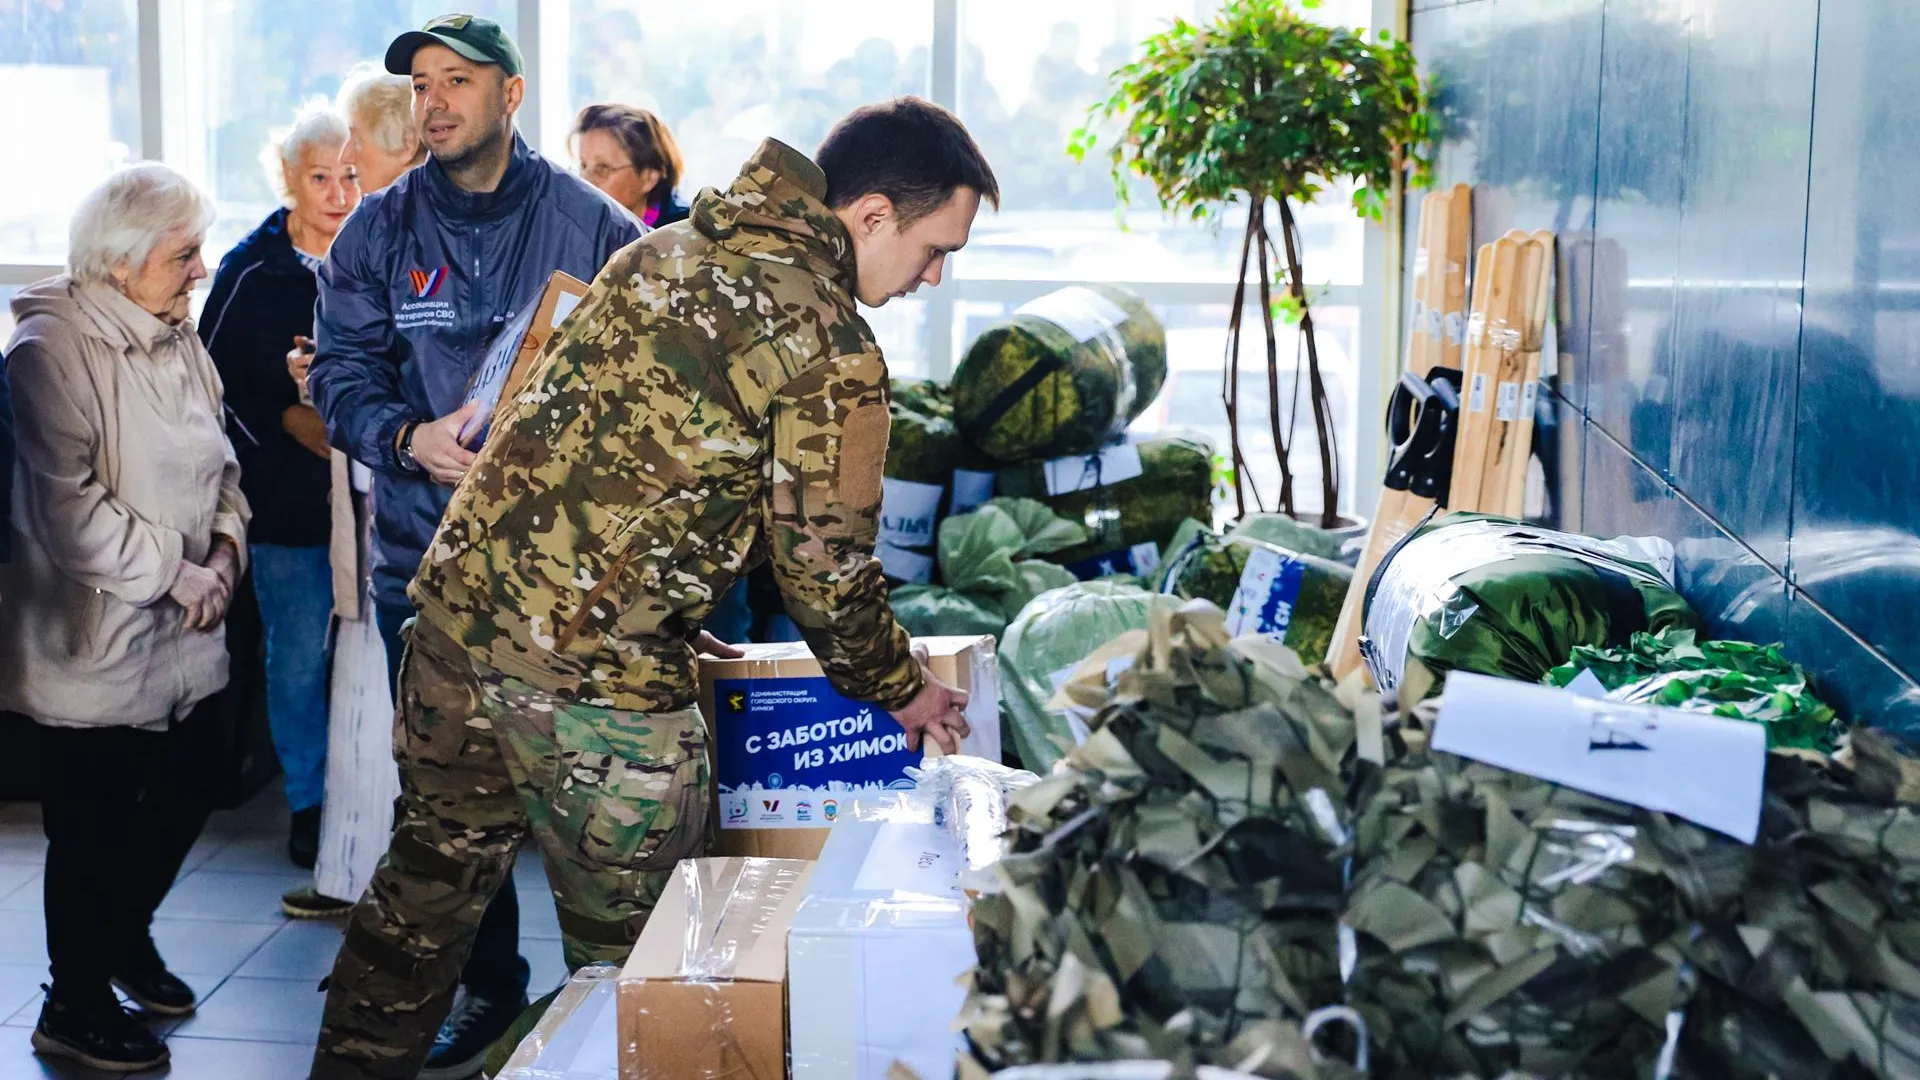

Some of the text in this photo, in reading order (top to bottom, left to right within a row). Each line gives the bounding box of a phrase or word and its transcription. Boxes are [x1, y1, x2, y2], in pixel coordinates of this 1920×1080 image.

[435, 310, 455, 319] СВО
[750, 690, 808, 698] АДМИНИСТРАЦИЯ
[750, 697, 793, 705] ГОРОДСКОГО
[745, 708, 873, 754] С ЗАБОТОЙ
[794, 732, 908, 771] ИЗ ХИМОК
